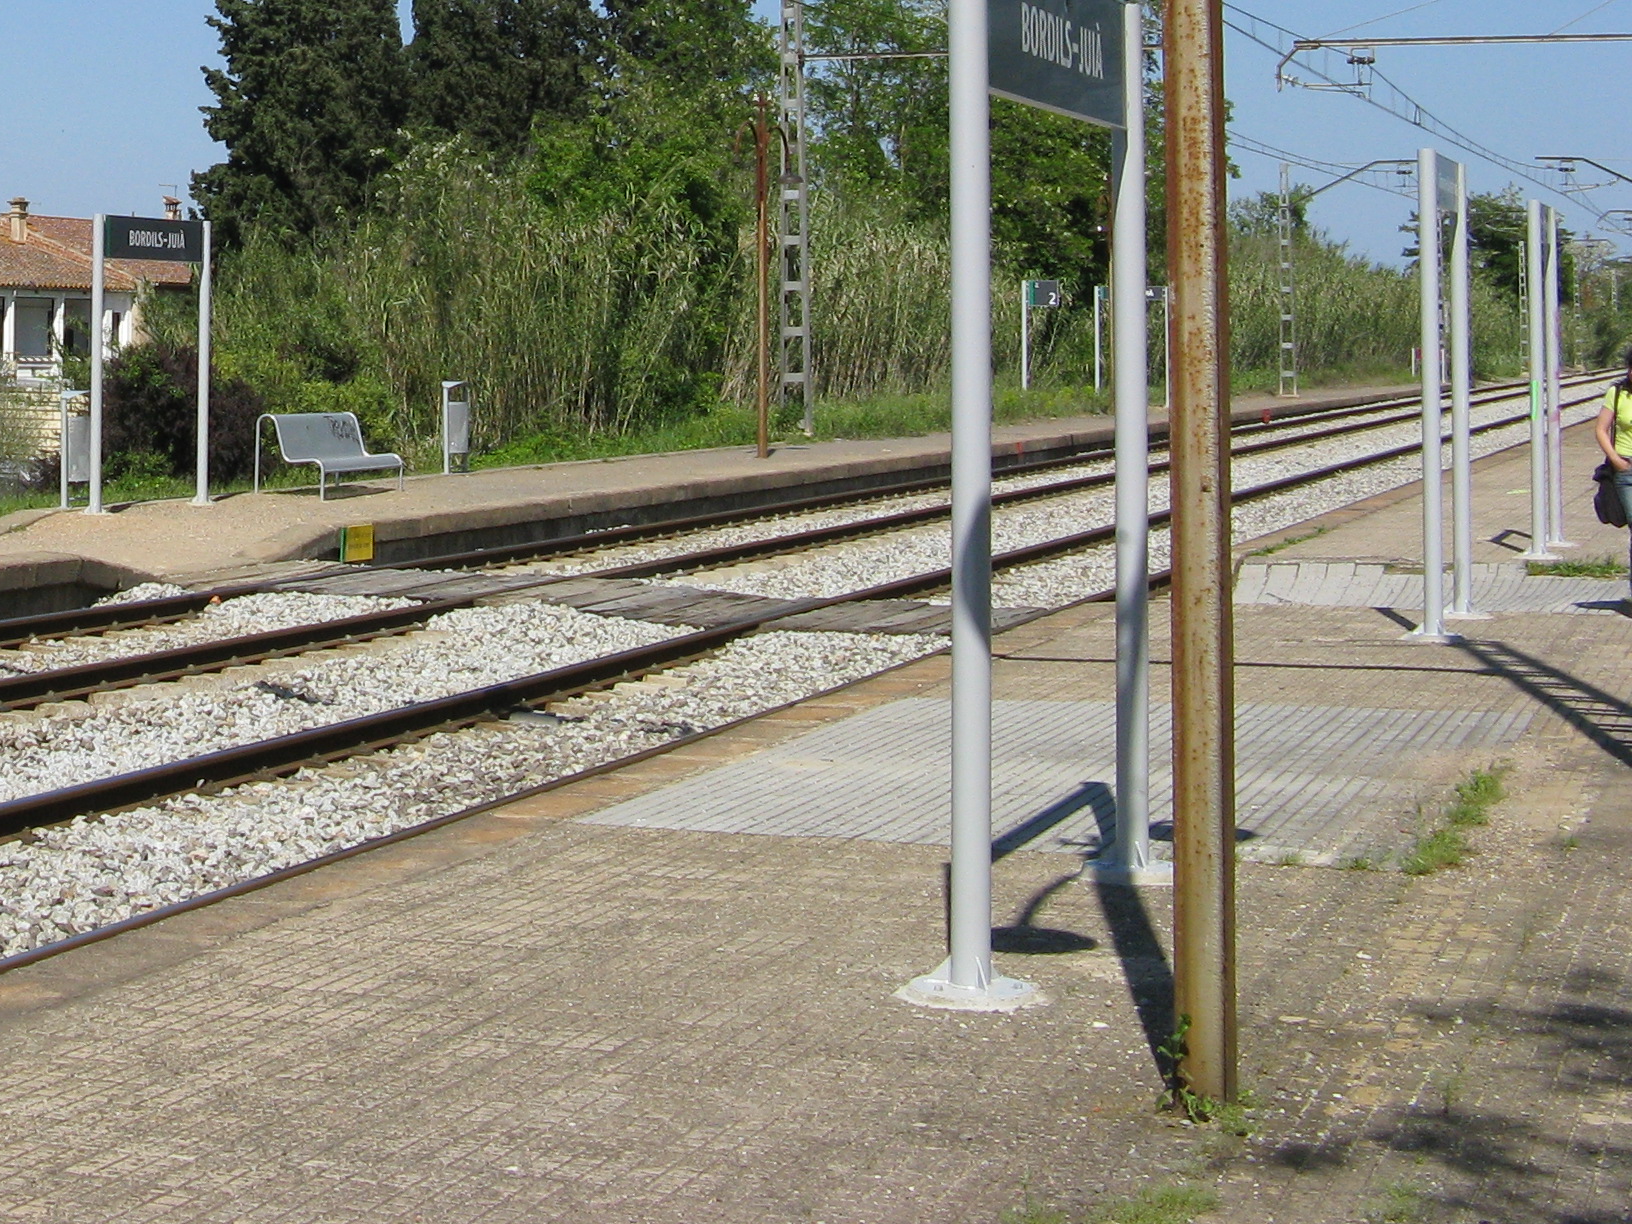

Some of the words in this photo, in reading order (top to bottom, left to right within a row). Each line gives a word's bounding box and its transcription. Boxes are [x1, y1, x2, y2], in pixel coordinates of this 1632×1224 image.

[1021, 1, 1104, 80] BORDILS-JUIÀ
[128, 229, 186, 249] BORDILS-JUIÀ
[1048, 291, 1057, 305] 2
